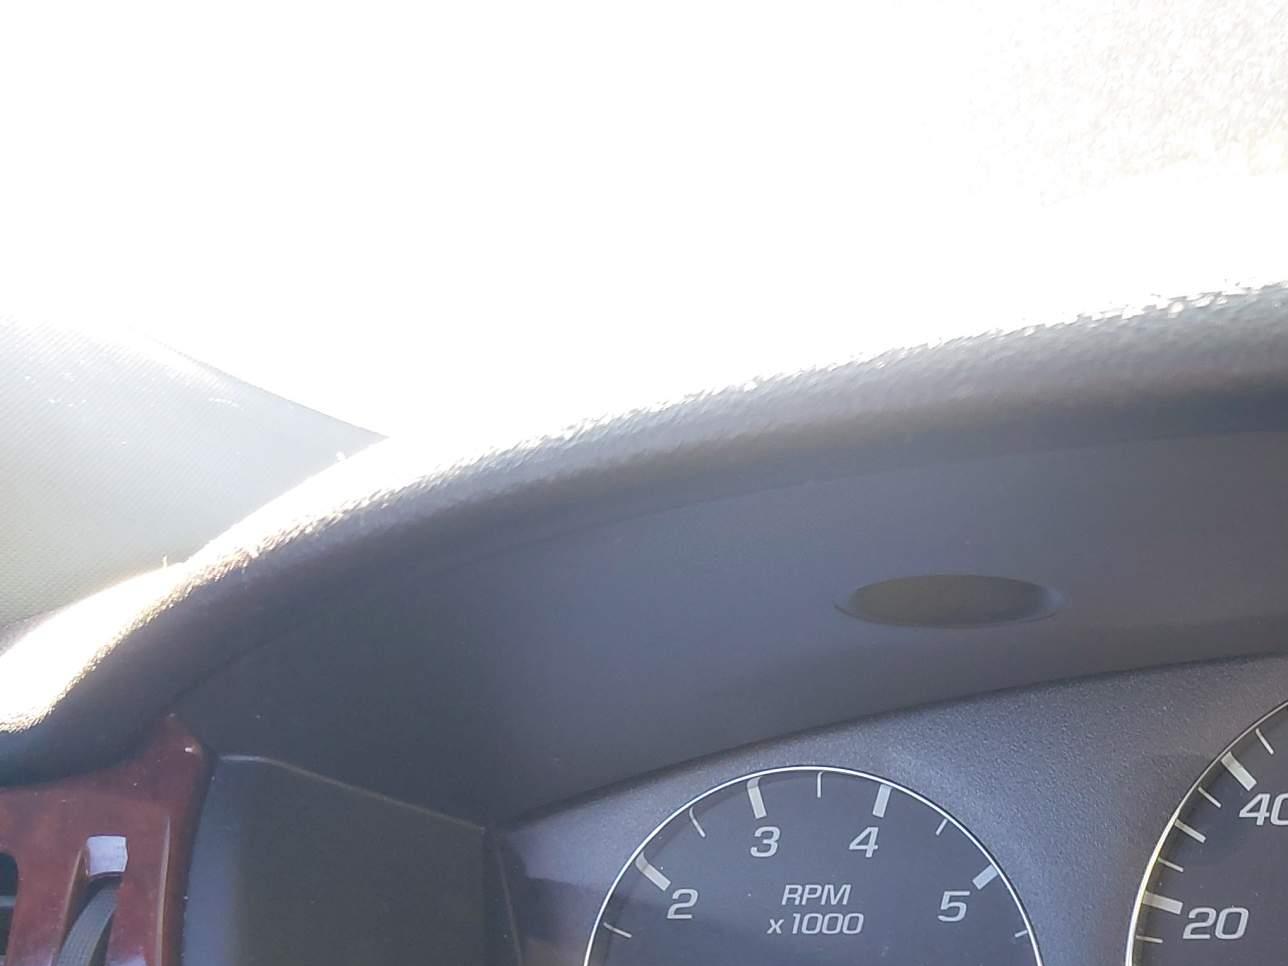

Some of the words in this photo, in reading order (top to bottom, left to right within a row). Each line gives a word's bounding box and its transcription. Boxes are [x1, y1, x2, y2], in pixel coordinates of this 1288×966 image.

[749, 826, 781, 858] 3
[848, 826, 879, 858] 4
[666, 888, 698, 920] 2
[780, 883, 851, 906] RPM
[937, 891, 970, 922] 5
[766, 920, 784, 935] x
[790, 912, 864, 936] 1000
[1182, 907, 1250, 940] 20
